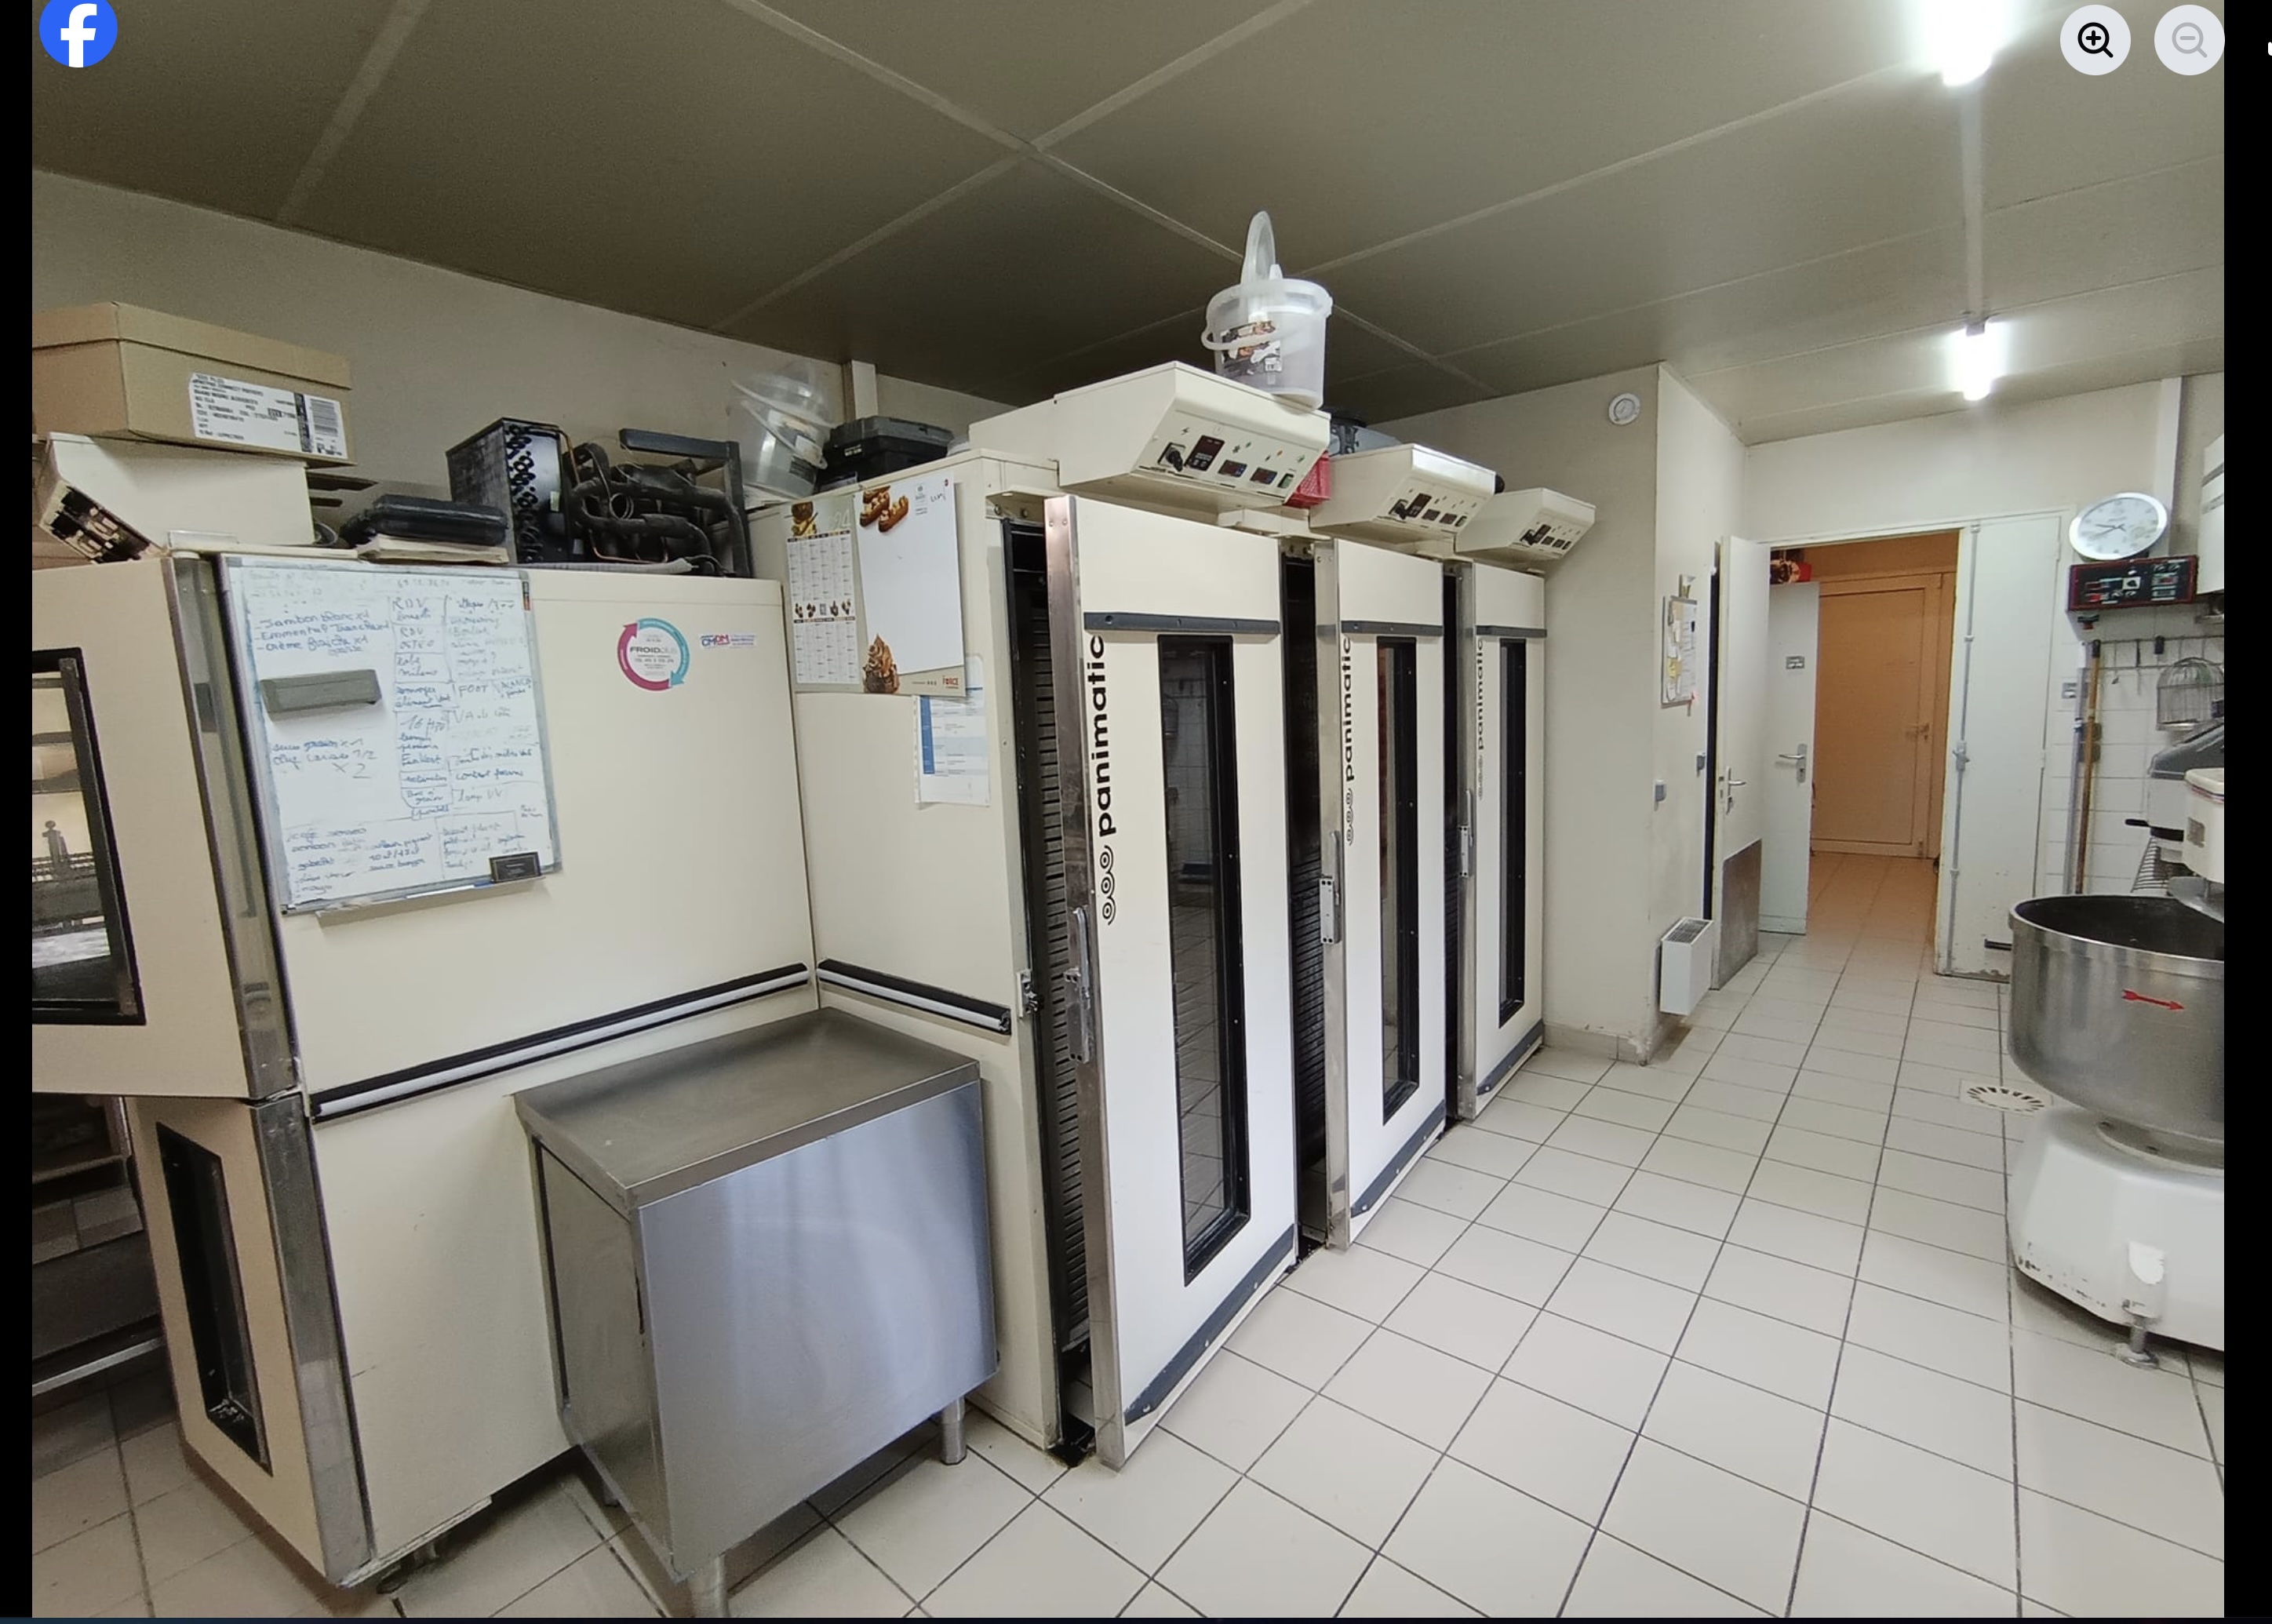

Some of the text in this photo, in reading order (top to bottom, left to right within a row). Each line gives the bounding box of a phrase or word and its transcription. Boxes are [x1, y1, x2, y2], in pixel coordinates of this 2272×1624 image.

[458, 684, 489, 698] FOOT
[1087, 635, 1117, 836] panimatic
[1342, 637, 1355, 782] panimatic
